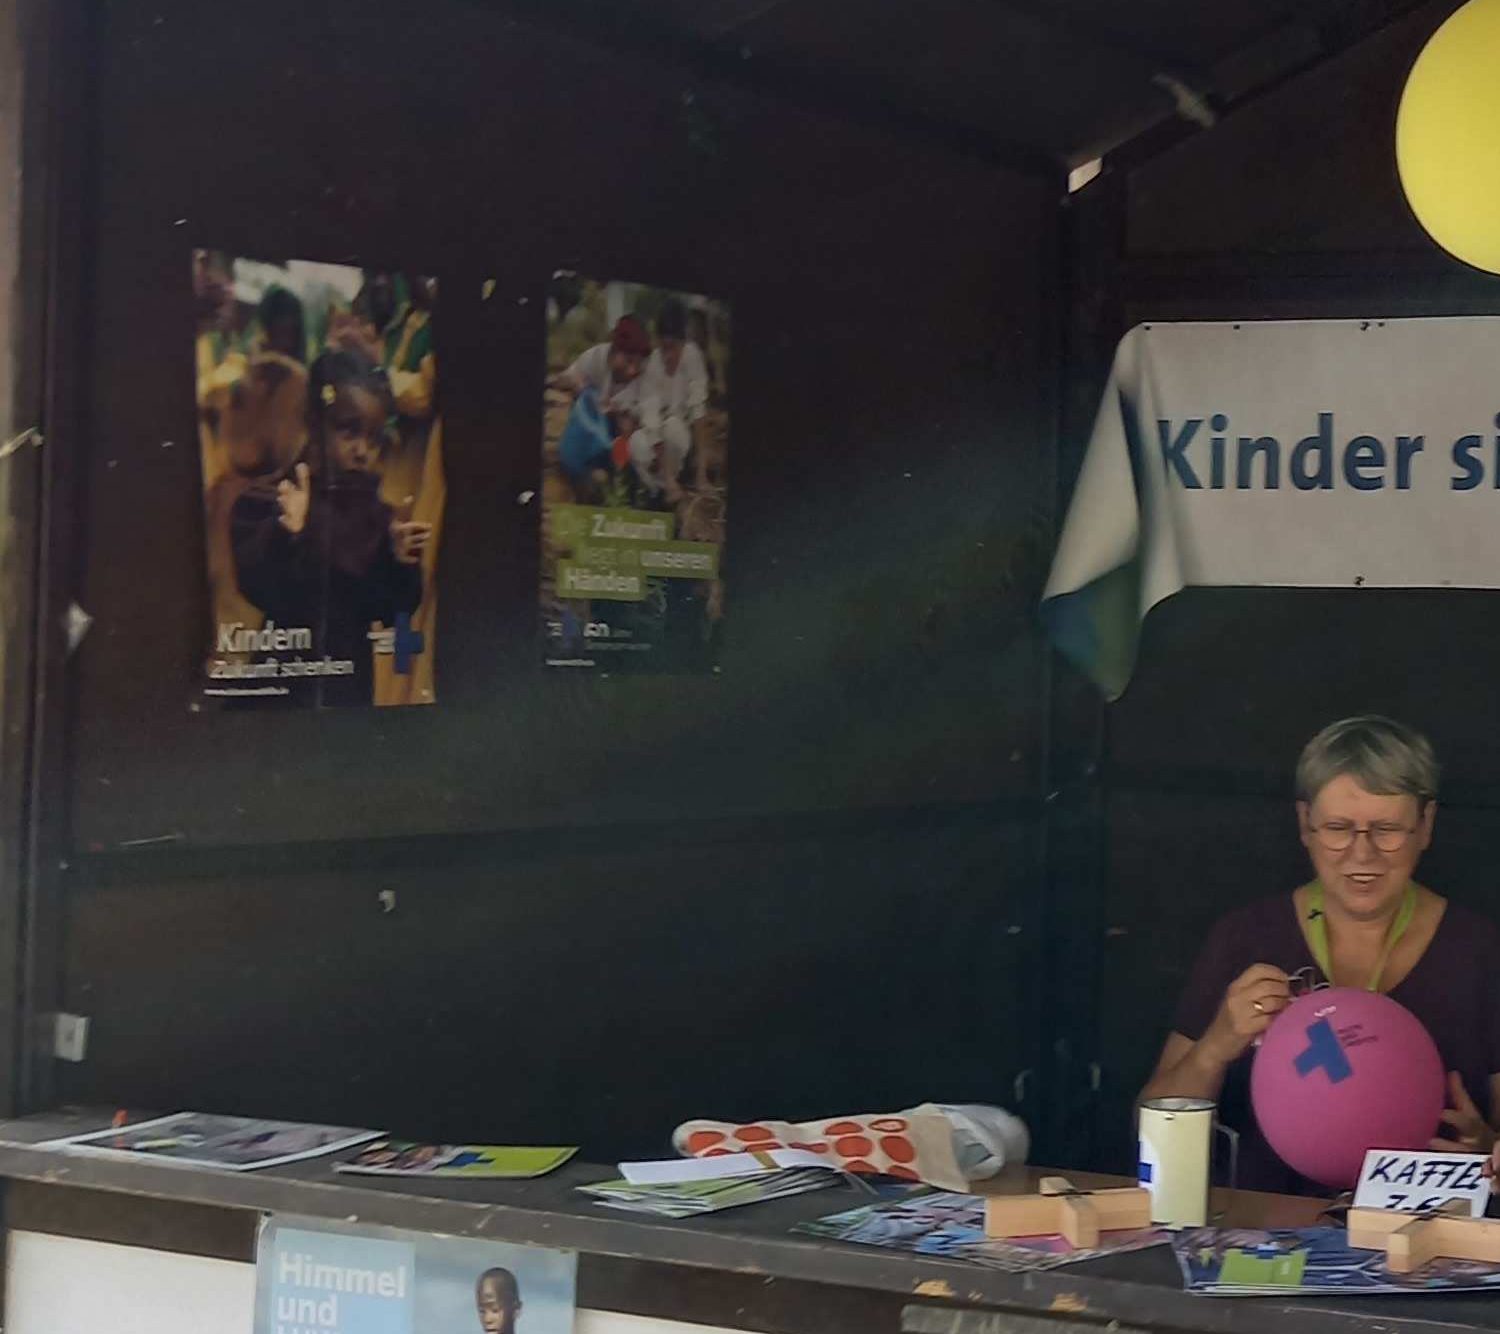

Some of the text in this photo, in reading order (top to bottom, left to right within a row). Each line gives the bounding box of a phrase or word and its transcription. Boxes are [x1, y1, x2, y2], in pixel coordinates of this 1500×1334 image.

[1157, 412, 1425, 491] Kinder
[278, 1250, 407, 1299] Himmel
[277, 1292, 339, 1327] und
